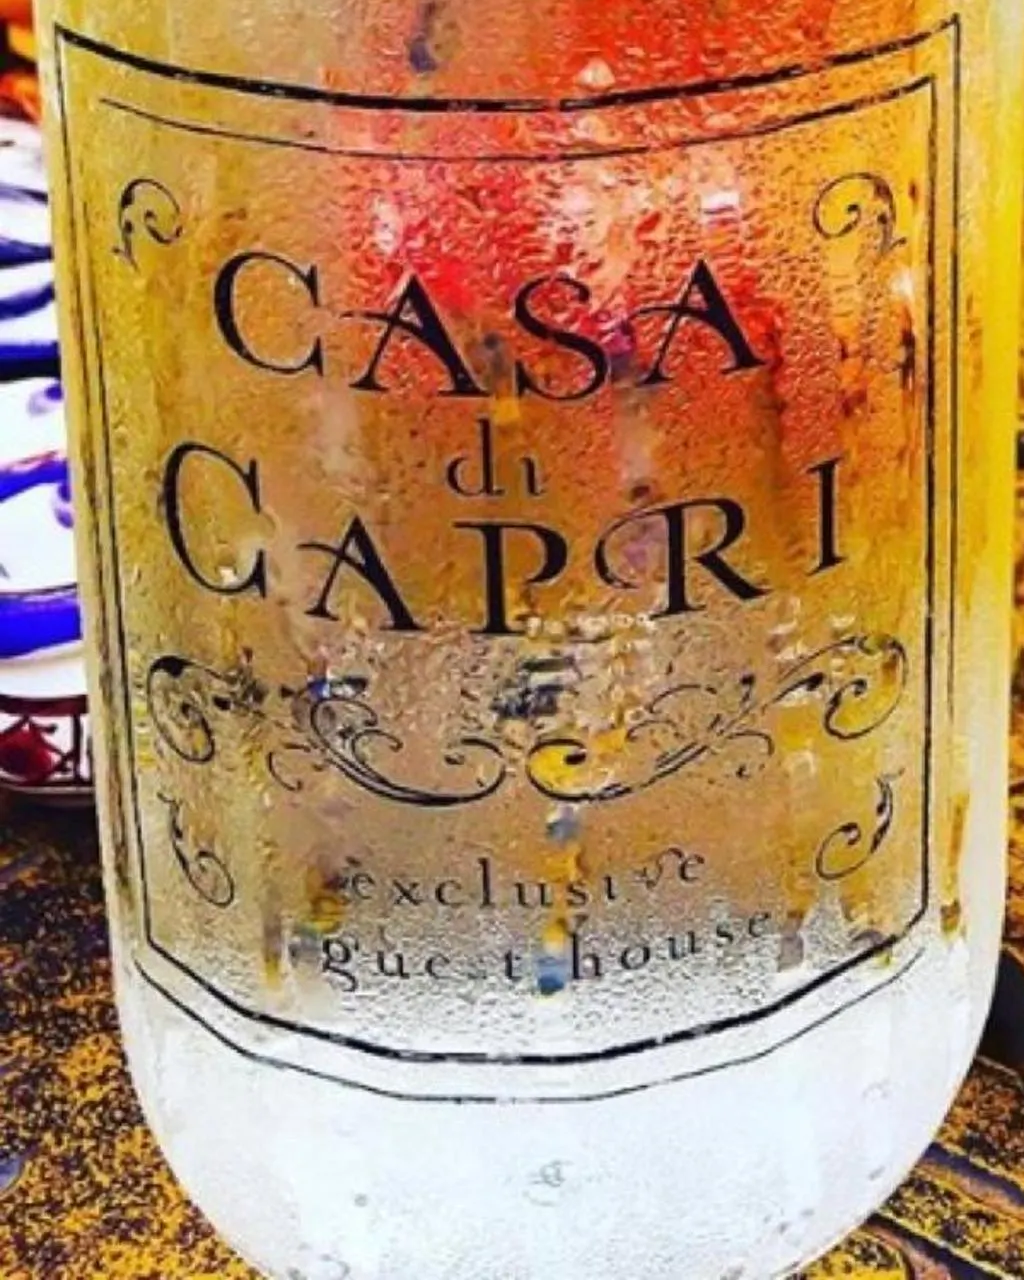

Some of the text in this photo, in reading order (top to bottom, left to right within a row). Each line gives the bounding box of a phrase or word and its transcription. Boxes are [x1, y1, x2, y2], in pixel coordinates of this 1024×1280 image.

[214, 252, 768, 400] CASA
[446, 418, 546, 497] di
[162, 442, 844, 634] CAPRI
[344, 847, 705, 908] exclusive
[571, 910, 771, 981] house
